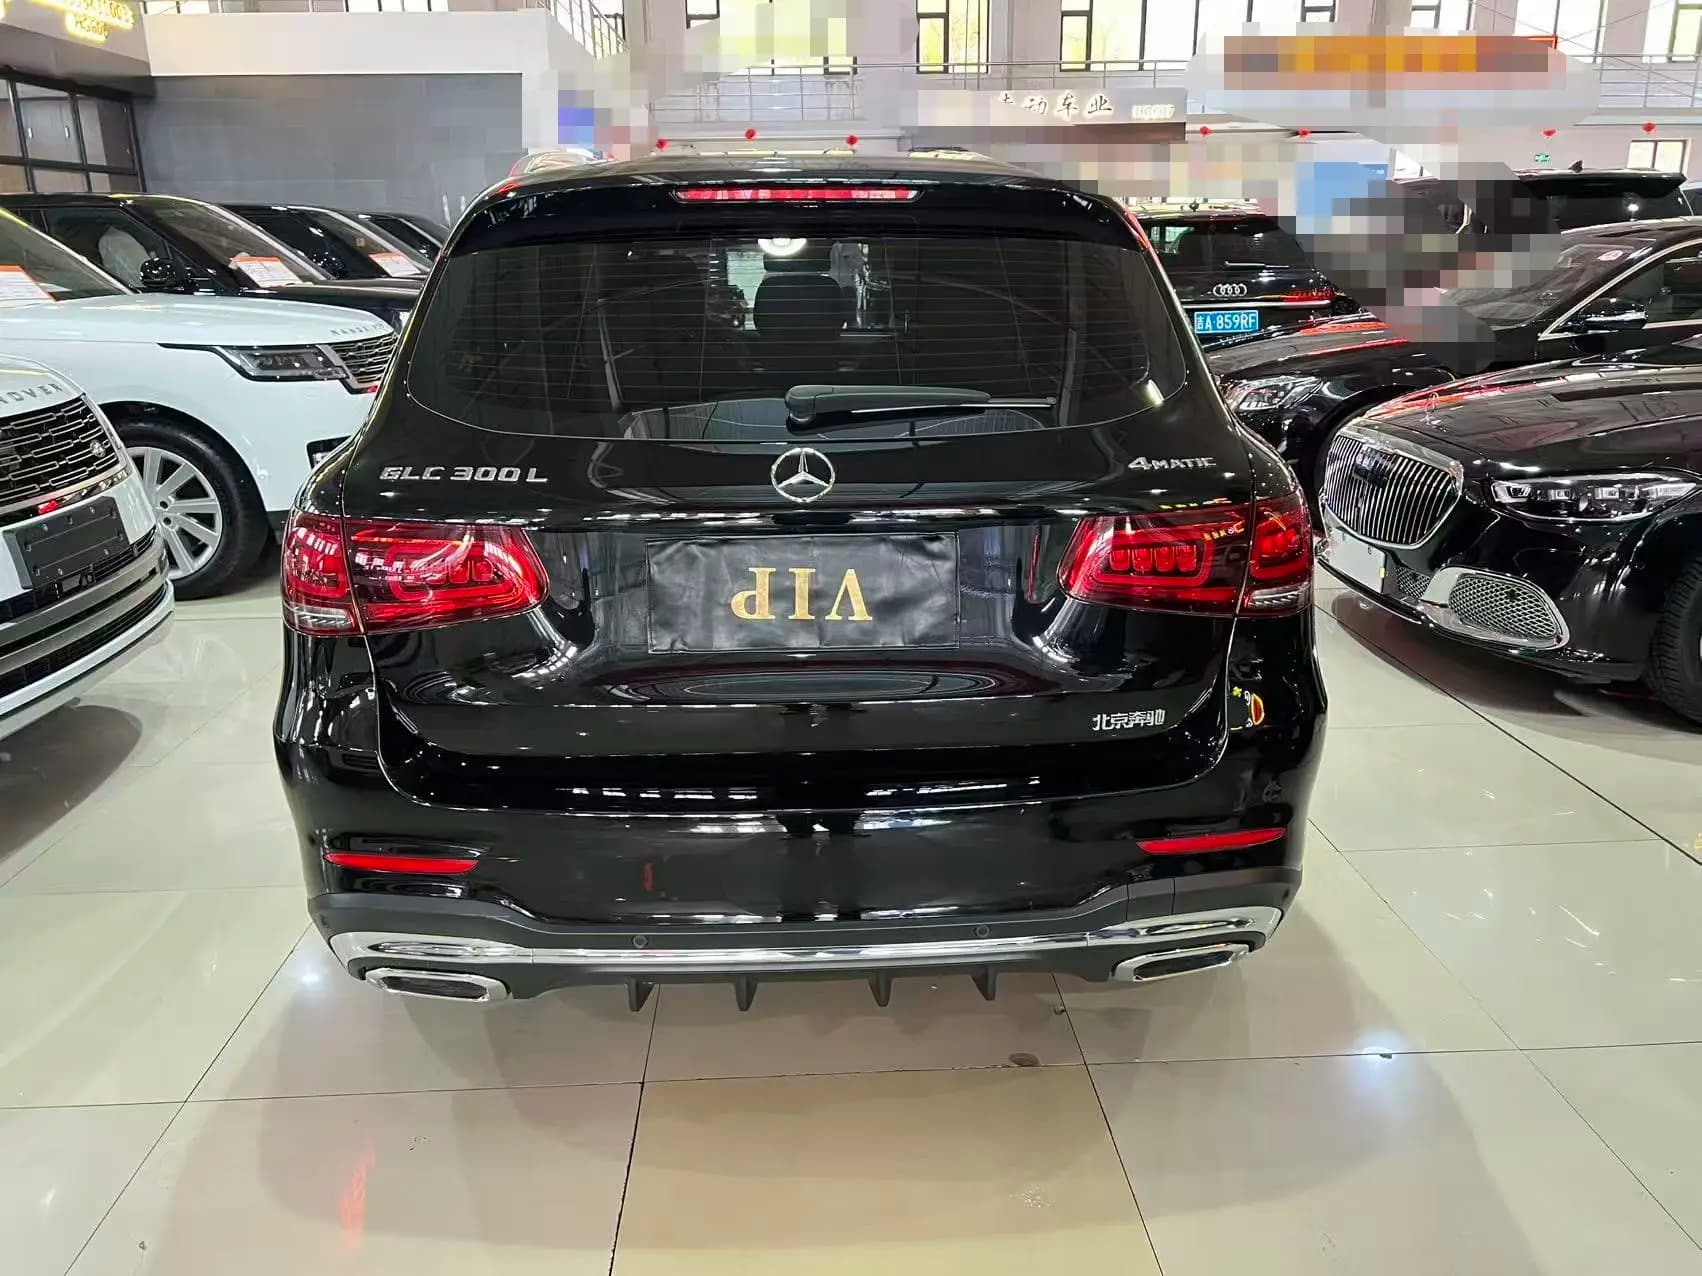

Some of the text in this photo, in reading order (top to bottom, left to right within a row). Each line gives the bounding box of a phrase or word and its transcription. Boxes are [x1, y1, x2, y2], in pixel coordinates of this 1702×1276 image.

[1128, 456, 1216, 470] 4MATIC
[379, 466, 548, 482] GLC 300 L
[730, 567, 873, 621] VIP
[1092, 708, 1166, 731] 北京奔驰
